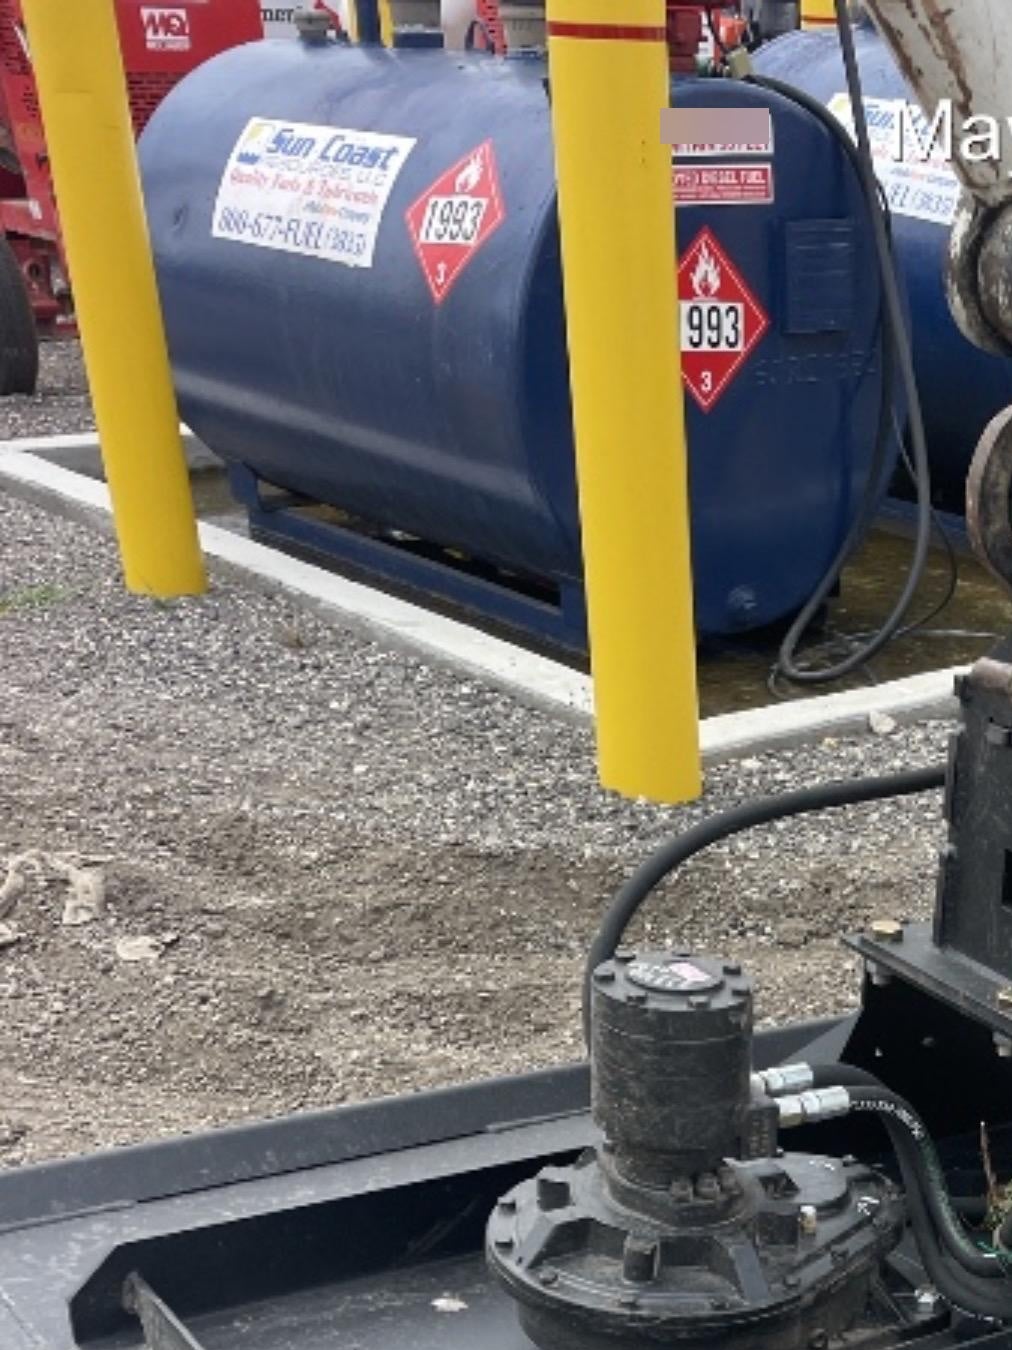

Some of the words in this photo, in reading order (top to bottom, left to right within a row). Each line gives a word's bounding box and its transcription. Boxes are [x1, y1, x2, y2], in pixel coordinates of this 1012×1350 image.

[266, 128, 315, 159] Sun
[318, 134, 400, 171] Coast
[425, 200, 483, 241] 1993
[687, 305, 739, 348] 993
[700, 370, 712, 391] 3
